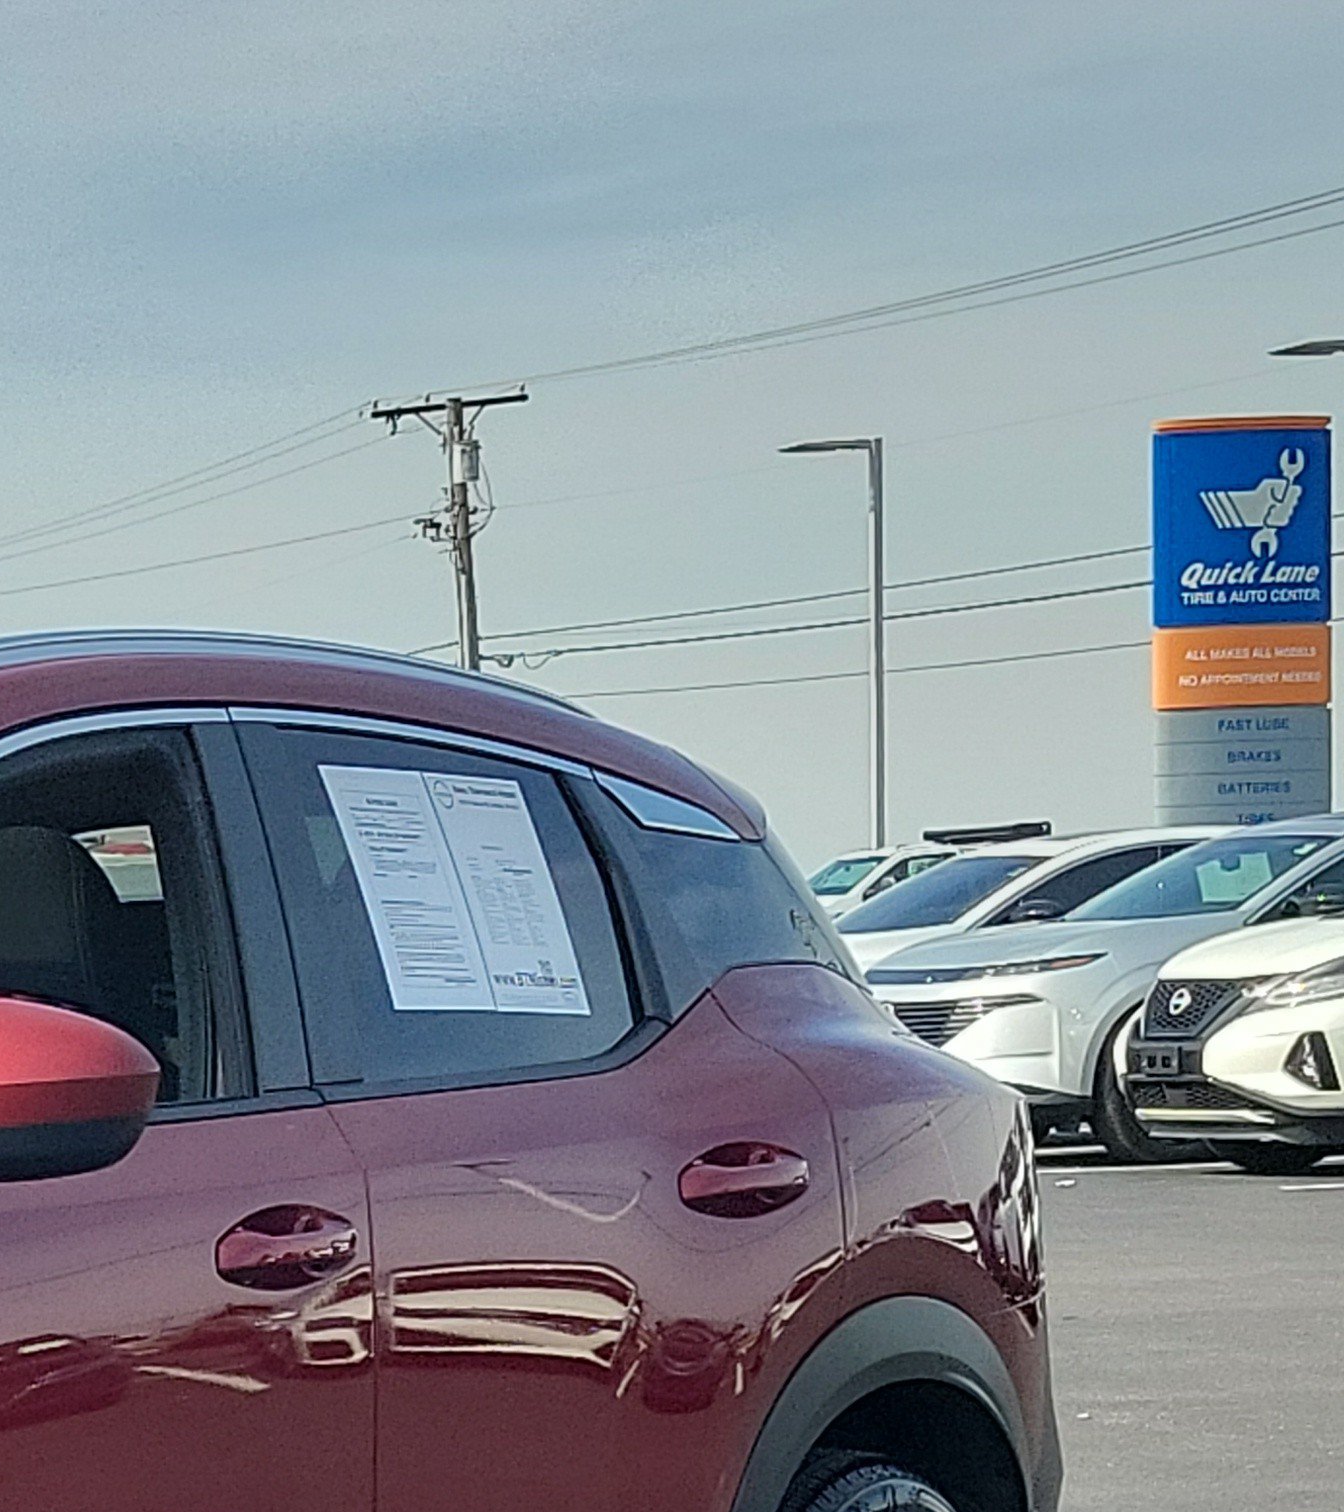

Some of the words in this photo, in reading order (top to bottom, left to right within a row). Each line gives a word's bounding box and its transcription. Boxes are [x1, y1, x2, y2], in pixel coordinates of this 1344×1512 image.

[1180, 561, 1259, 589] Quick
[1260, 560, 1320, 584] Lane
[1180, 591, 1215, 605] TIRE
[1216, 590, 1227, 604] &
[1229, 589, 1267, 604] AUTO
[1270, 588, 1321, 602] CENTER
[1185, 649, 1208, 661] ALL
[1178, 675, 1198, 687] NO
[1218, 719, 1252, 732] FAST
[1227, 750, 1282, 763] BRAKES
[1217, 781, 1291, 795] BATTERIES
